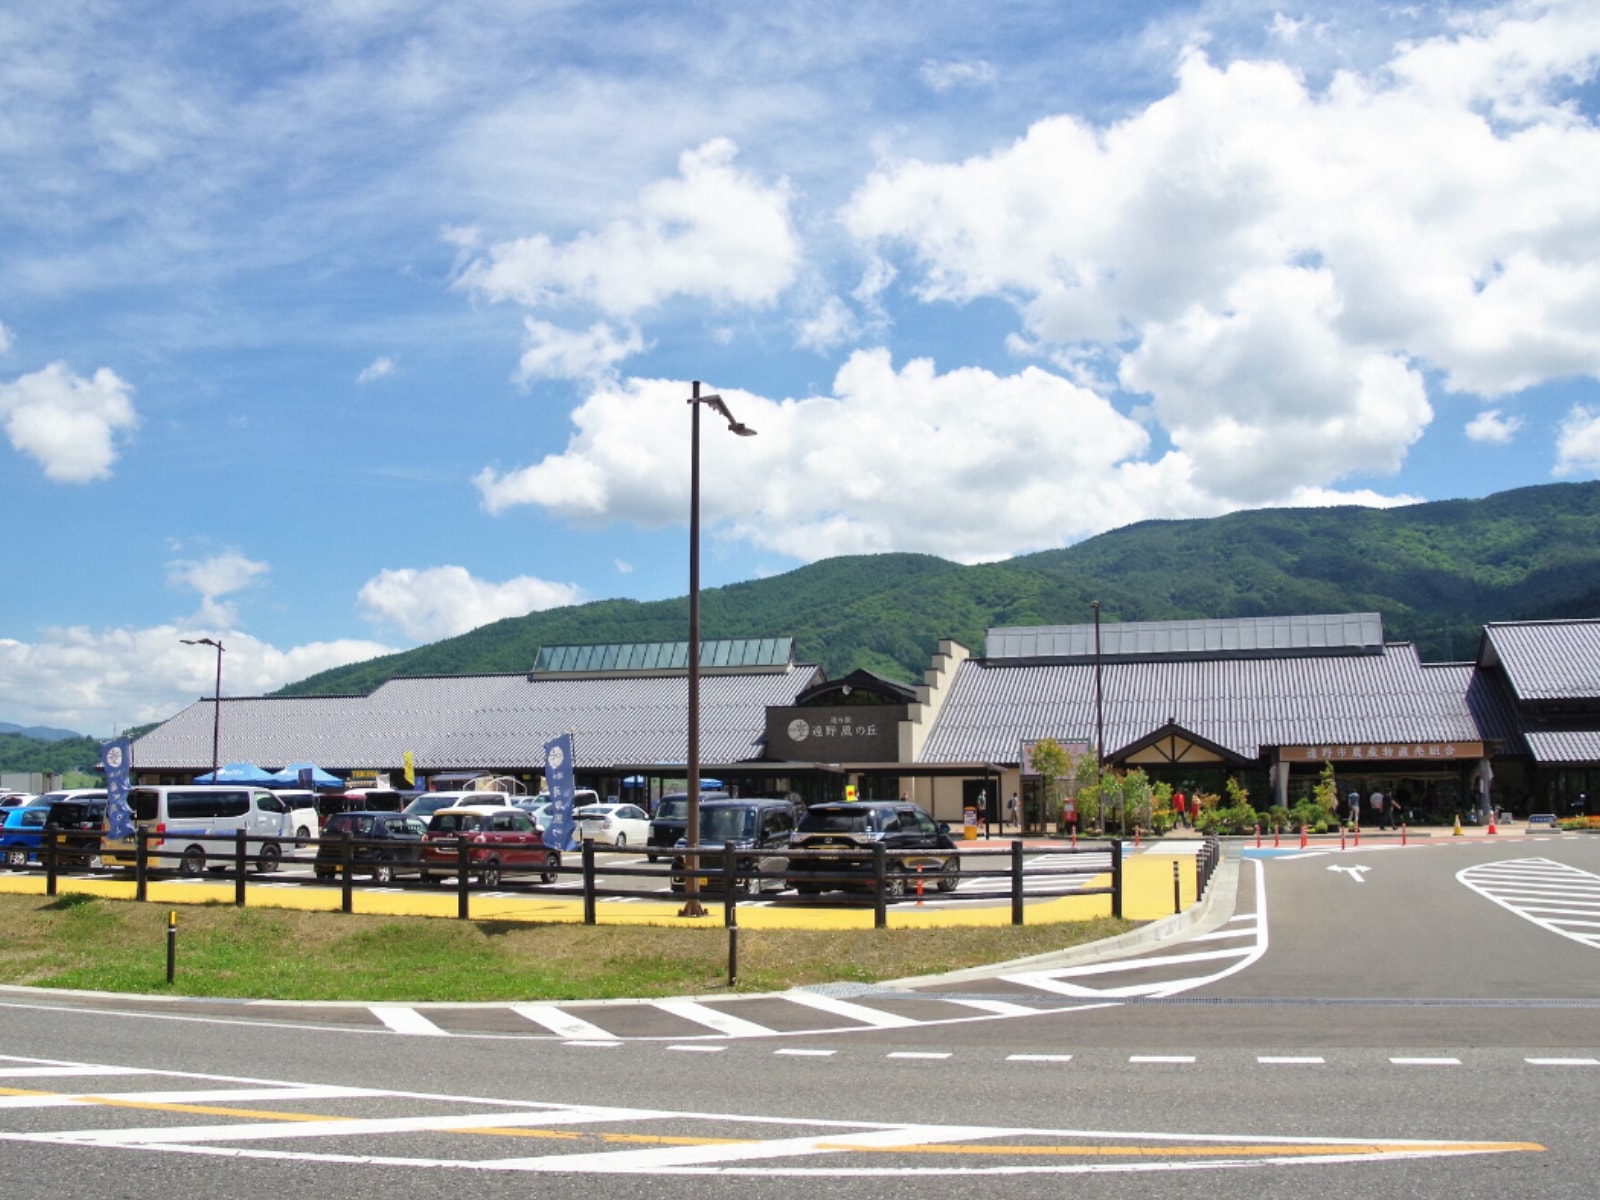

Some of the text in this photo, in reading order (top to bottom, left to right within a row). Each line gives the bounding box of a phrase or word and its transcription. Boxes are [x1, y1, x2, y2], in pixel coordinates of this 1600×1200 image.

[812, 723, 878, 737] 遠野風の丘
